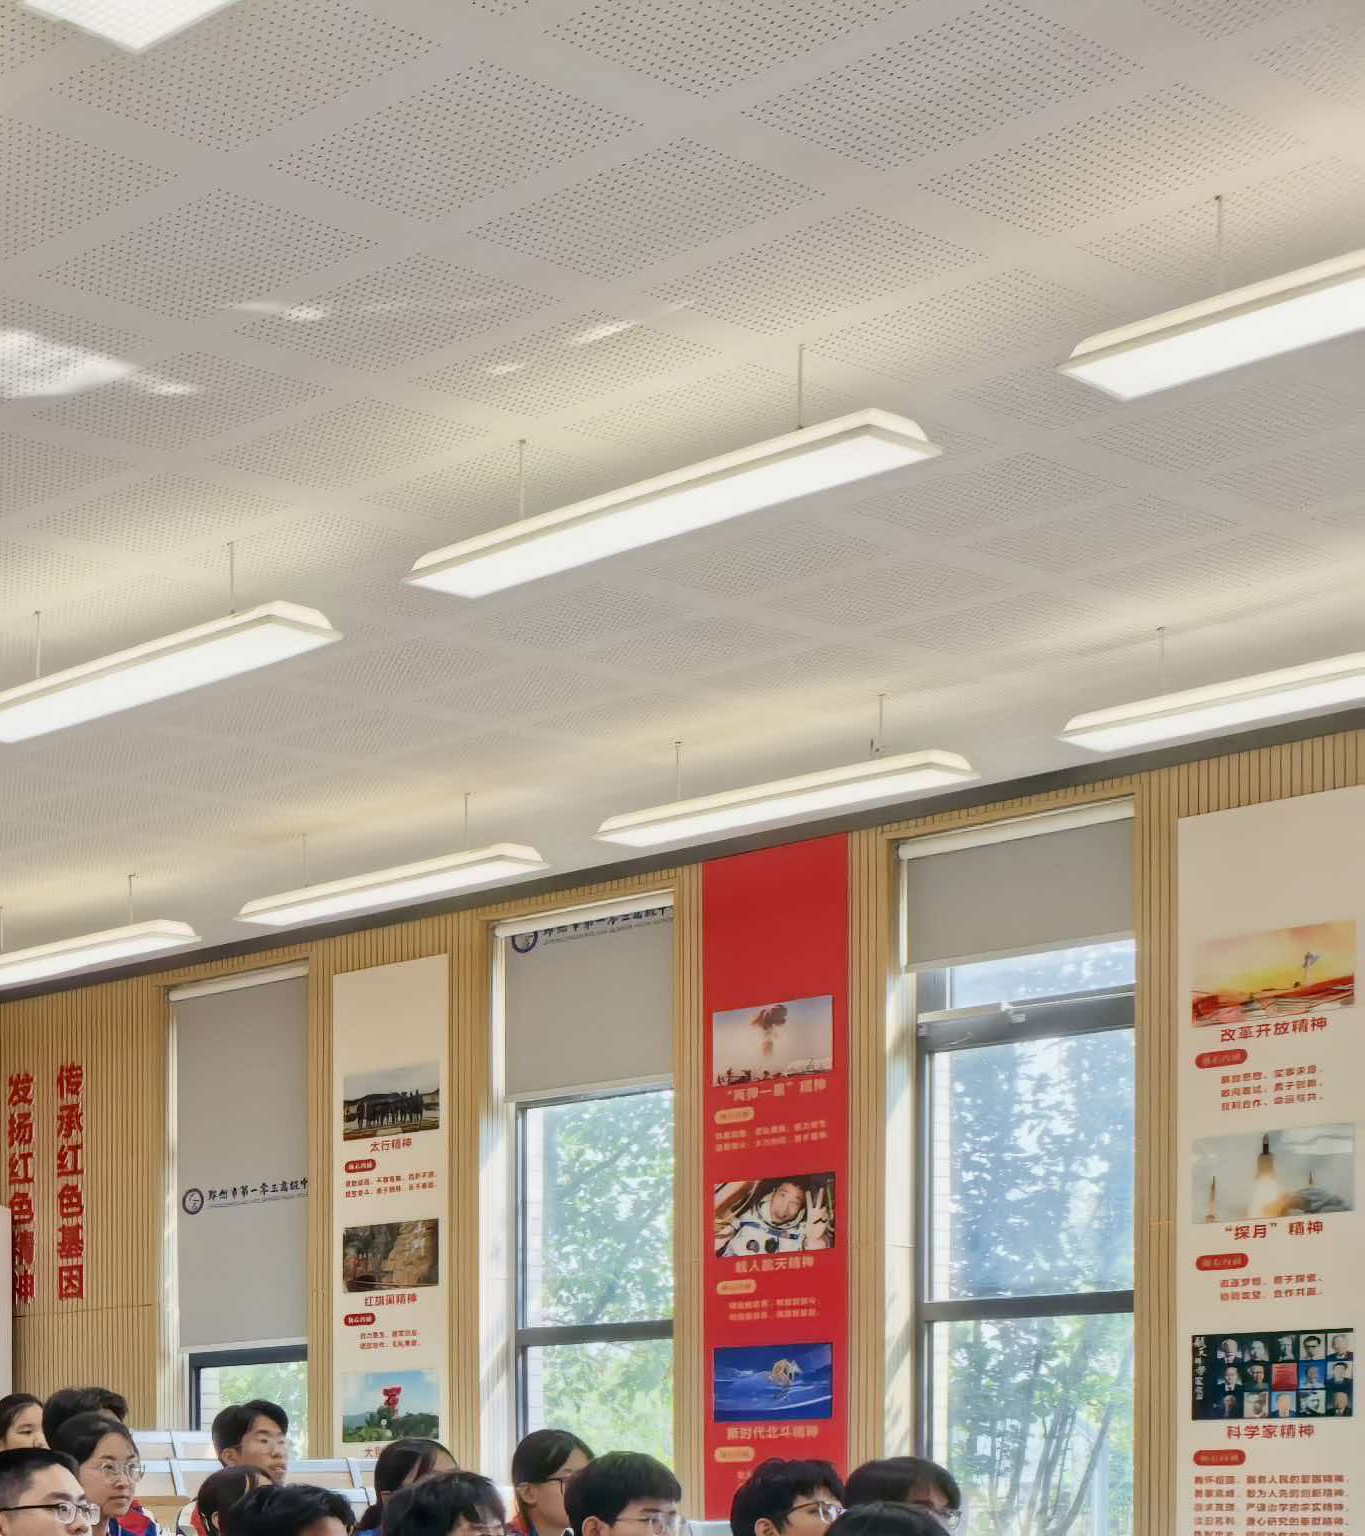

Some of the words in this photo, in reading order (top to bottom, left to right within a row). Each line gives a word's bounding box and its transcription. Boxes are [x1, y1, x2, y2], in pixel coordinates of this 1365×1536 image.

[1221, 1016, 1328, 1042] 改革开放精神
[56, 1063, 84, 1300] 传承红色基因
[1226, 1423, 1315, 1439] 科学家精神
